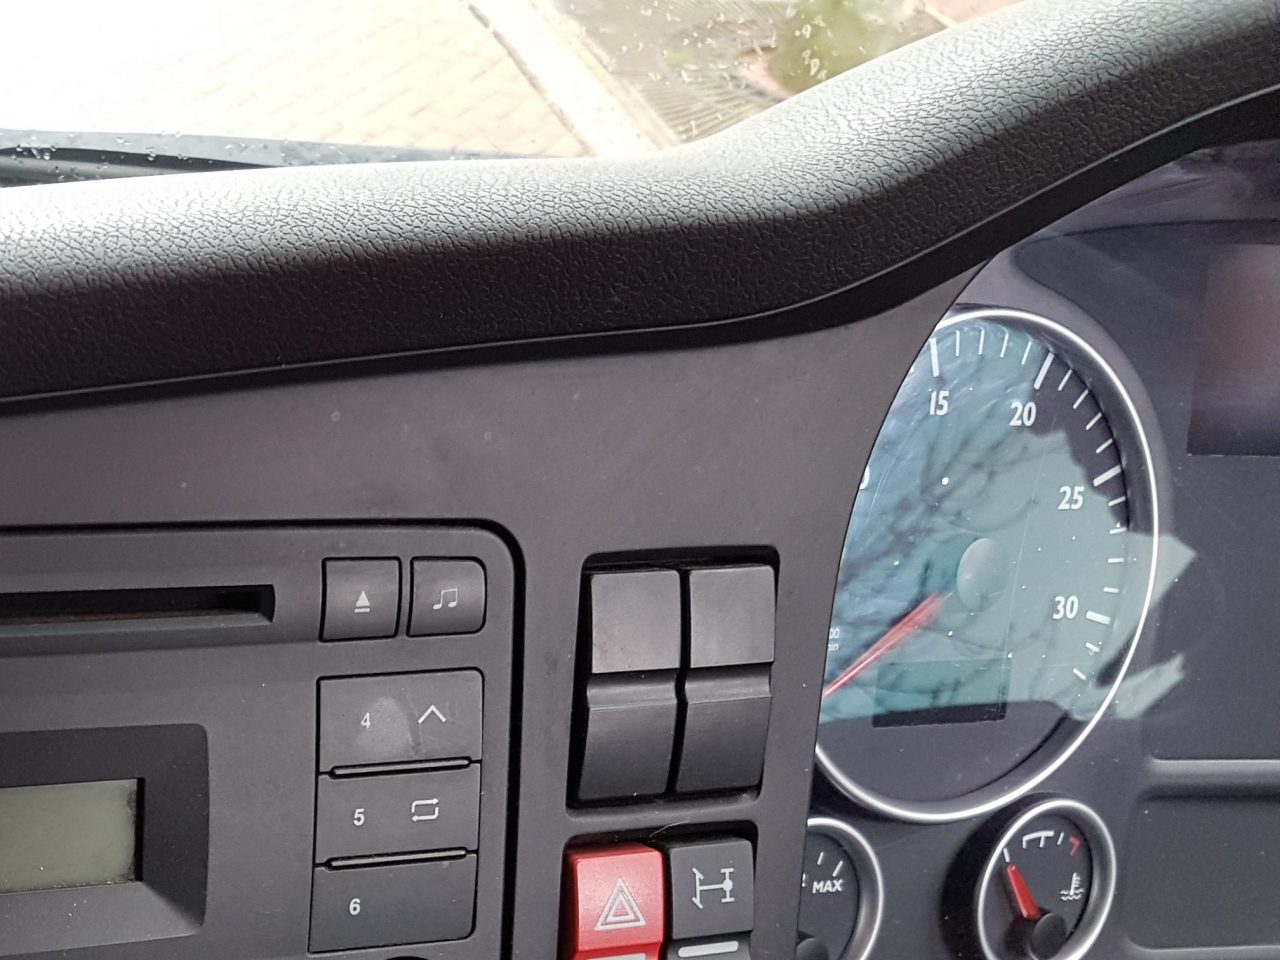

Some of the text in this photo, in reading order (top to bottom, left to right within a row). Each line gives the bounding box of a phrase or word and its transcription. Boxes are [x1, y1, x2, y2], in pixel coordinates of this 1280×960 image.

[929, 390, 949, 415] 15
[1009, 401, 1036, 427] 20
[1058, 485, 1084, 510] 25
[1053, 595, 1079, 619] 30
[360, 711, 371, 729] 4
[353, 808, 365, 826] 5
[812, 879, 843, 893] MAX
[349, 898, 361, 915] 6
